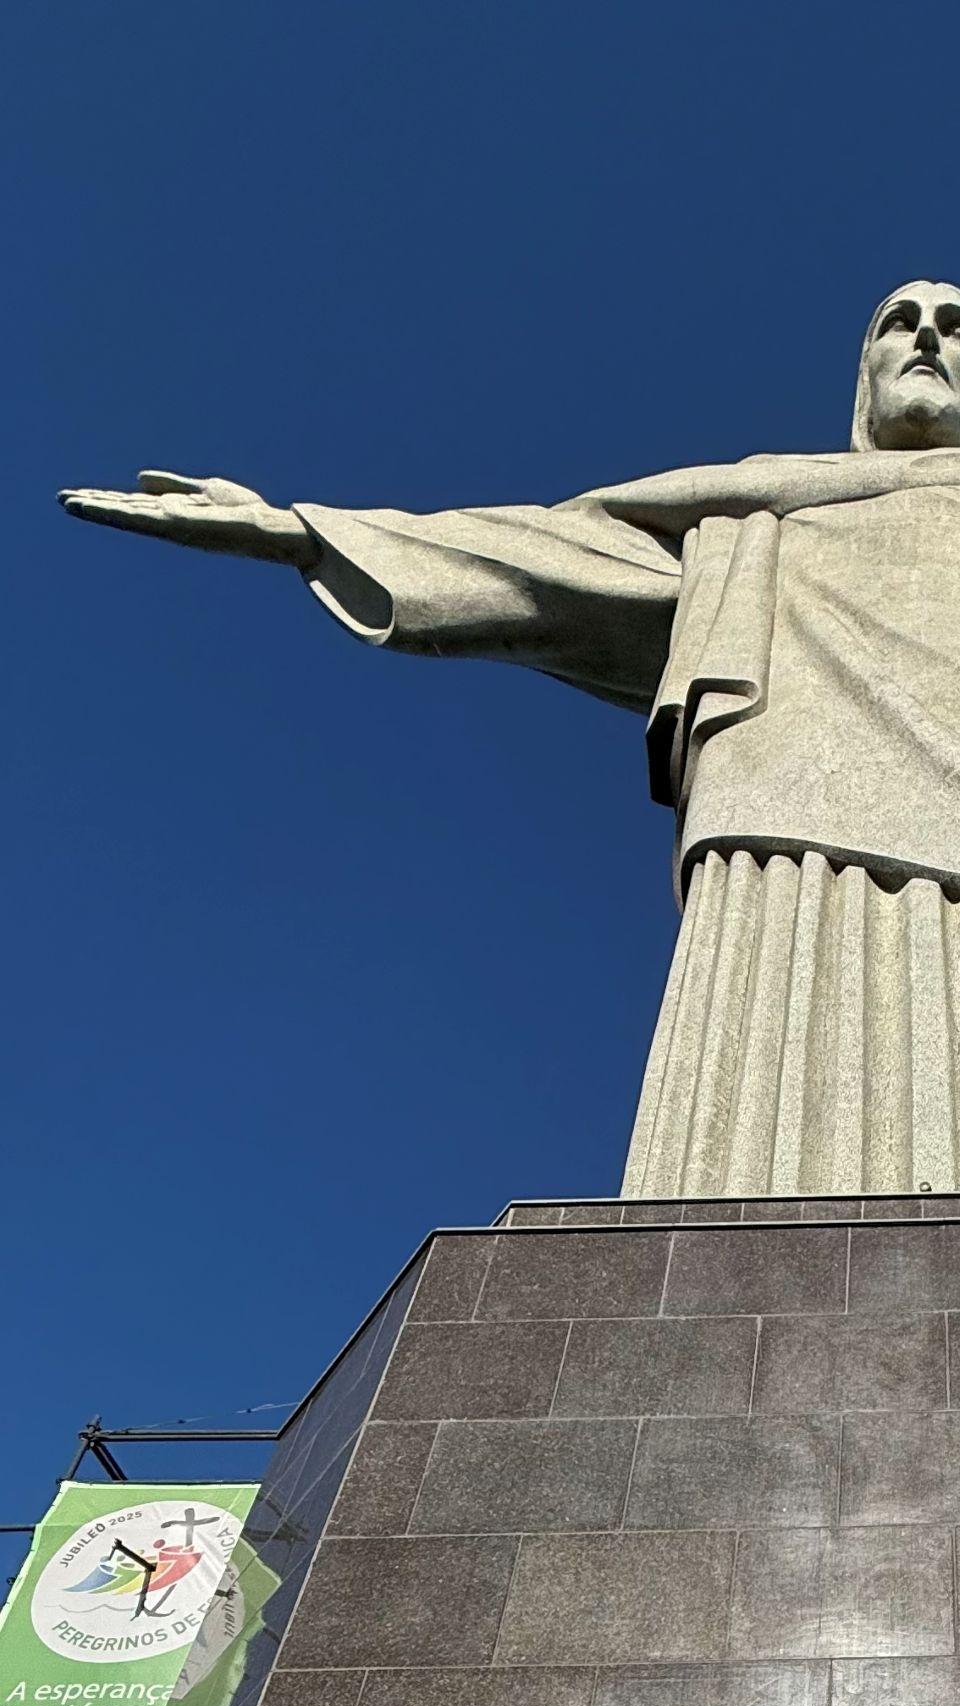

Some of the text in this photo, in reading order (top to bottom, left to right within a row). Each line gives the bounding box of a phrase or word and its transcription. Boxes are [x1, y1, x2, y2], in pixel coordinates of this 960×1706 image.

[59, 1510, 143, 1568] JUBILEO 2025
[51, 1612, 200, 1651] PEREGRINOS DE
[6, 1681, 175, 1705] A esperança
